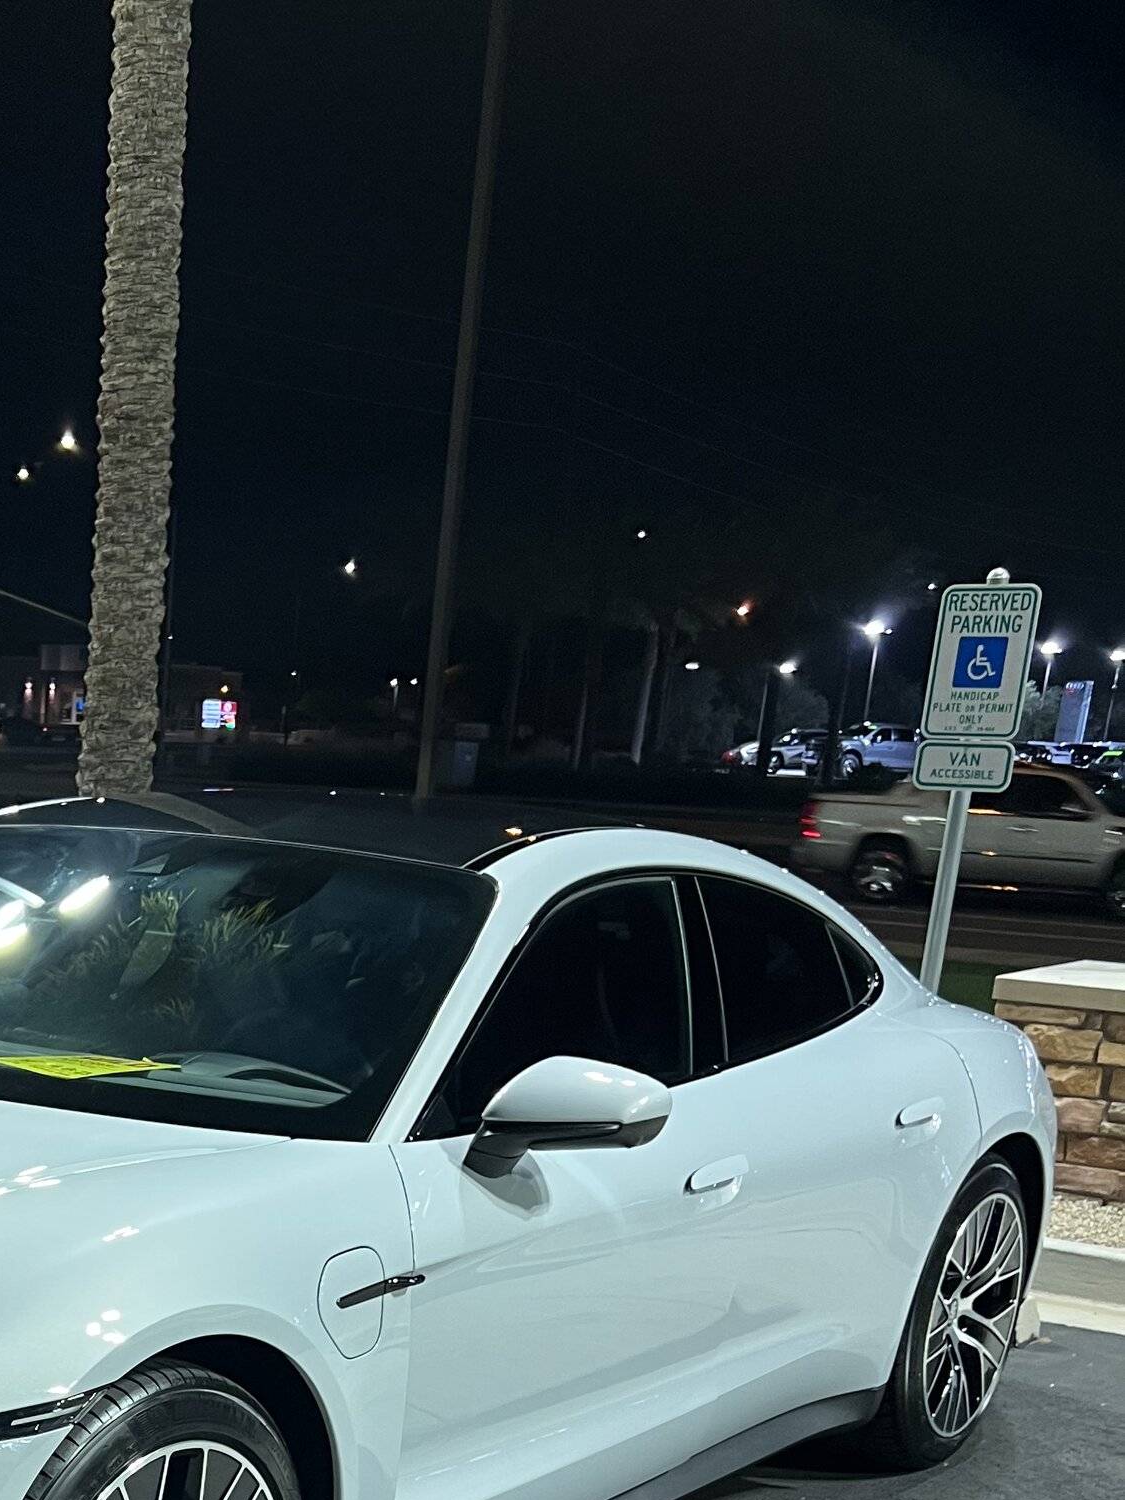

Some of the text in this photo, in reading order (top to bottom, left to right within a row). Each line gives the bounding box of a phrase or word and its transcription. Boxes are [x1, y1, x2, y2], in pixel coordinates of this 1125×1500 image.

[948, 593, 1032, 612] RESERVED
[950, 615, 1023, 634] PARKING
[950, 691, 999, 701] HANDICAP
[932, 702, 962, 713] PLATE
[978, 703, 1014, 713] PERMIT
[959, 714, 983, 725] ONLY
[949, 751, 981, 767] VAN
[930, 768, 995, 780] ACCESSIBLE
